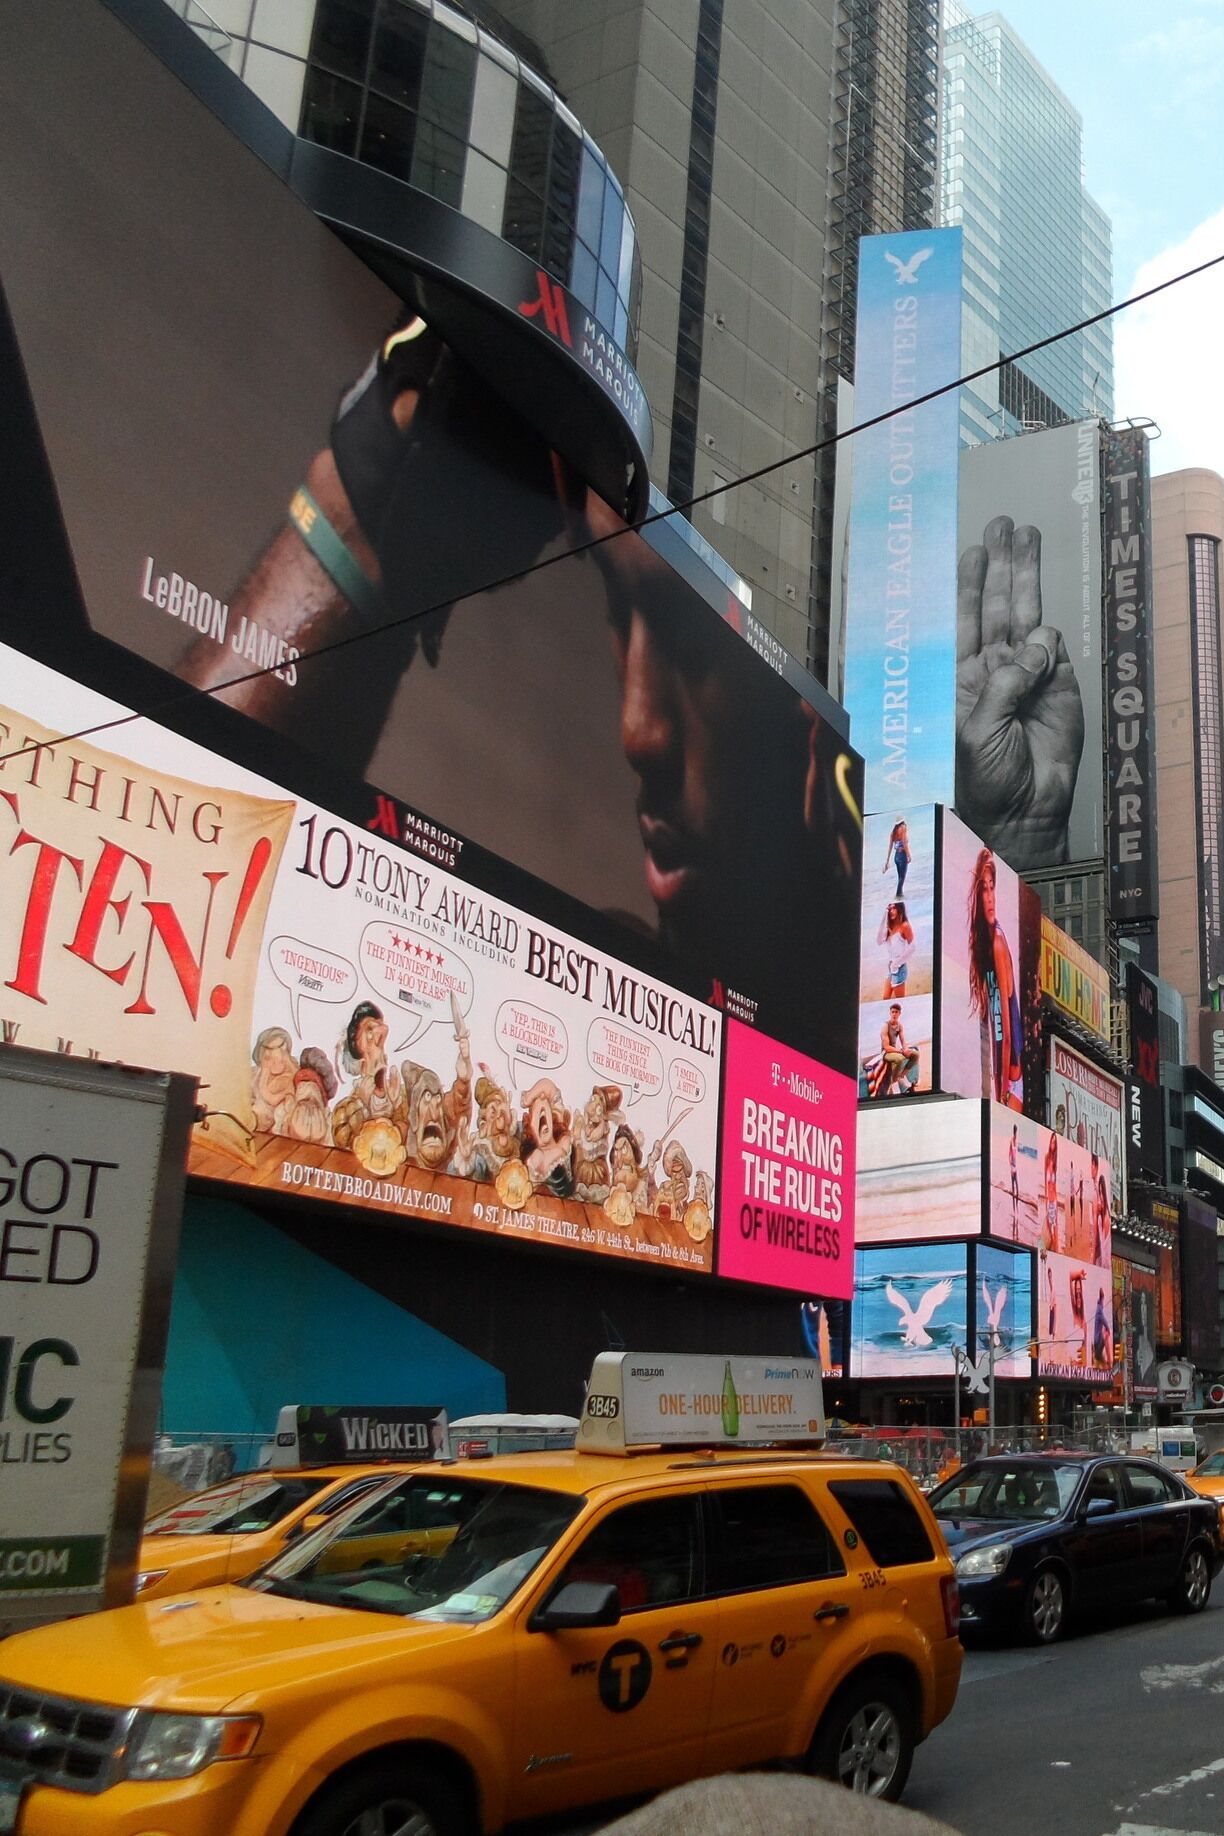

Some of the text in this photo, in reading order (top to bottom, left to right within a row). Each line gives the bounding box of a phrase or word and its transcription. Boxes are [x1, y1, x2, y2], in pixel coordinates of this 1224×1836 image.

[581, 341, 640, 427] MARQUIS
[583, 315, 646, 405] MARRIOTT
[881, 294, 918, 787] AMERICAN EAGLE OUTFITTERS
[140, 555, 301, 688] LeBRON JAMES
[746, 615, 790, 664] MARRIOTT
[746, 632, 784, 676] MARQUIS
[1110, 471, 1145, 865] TIMES SQUARE
[404, 829, 458, 868] MARQUIS
[405, 812, 465, 854] MARRIOTT
[0, 788, 273, 1022] TEN!
[1118, 887, 1144, 900] NYC
[295, 814, 718, 1059] 10 TONY AWARD BEST MUSICAL!
[354, 887, 517, 969] NOMINATIONS INCLUDING
[726, 987, 759, 1012] MARRIOTT
[726, 1001, 756, 1023] MARQUIS
[1045, 944, 1072, 1006] FUN
[1074, 969, 1108, 1036] HOME
[1055, 1050, 1088, 1088] LOSER!
[741, 1097, 844, 1177] BREAKING
[1131, 1085, 1142, 1150] NEW
[281, 1161, 453, 1216] ROTTENBROADWAY.COM
[741, 1150, 843, 1224] THE RULES
[498, 1208, 537, 1233] JAMES
[740, 1203, 841, 1262] OF WIRELESS
[631, 1367, 665, 1378] amazon
[588, 1395, 618, 1418] 3B45
[659, 1393, 798, 1417] ONE-HOUR DELIVERY.
[0, 1432, 73, 1464] LIES
[857, 1568, 888, 1591] 3B45
